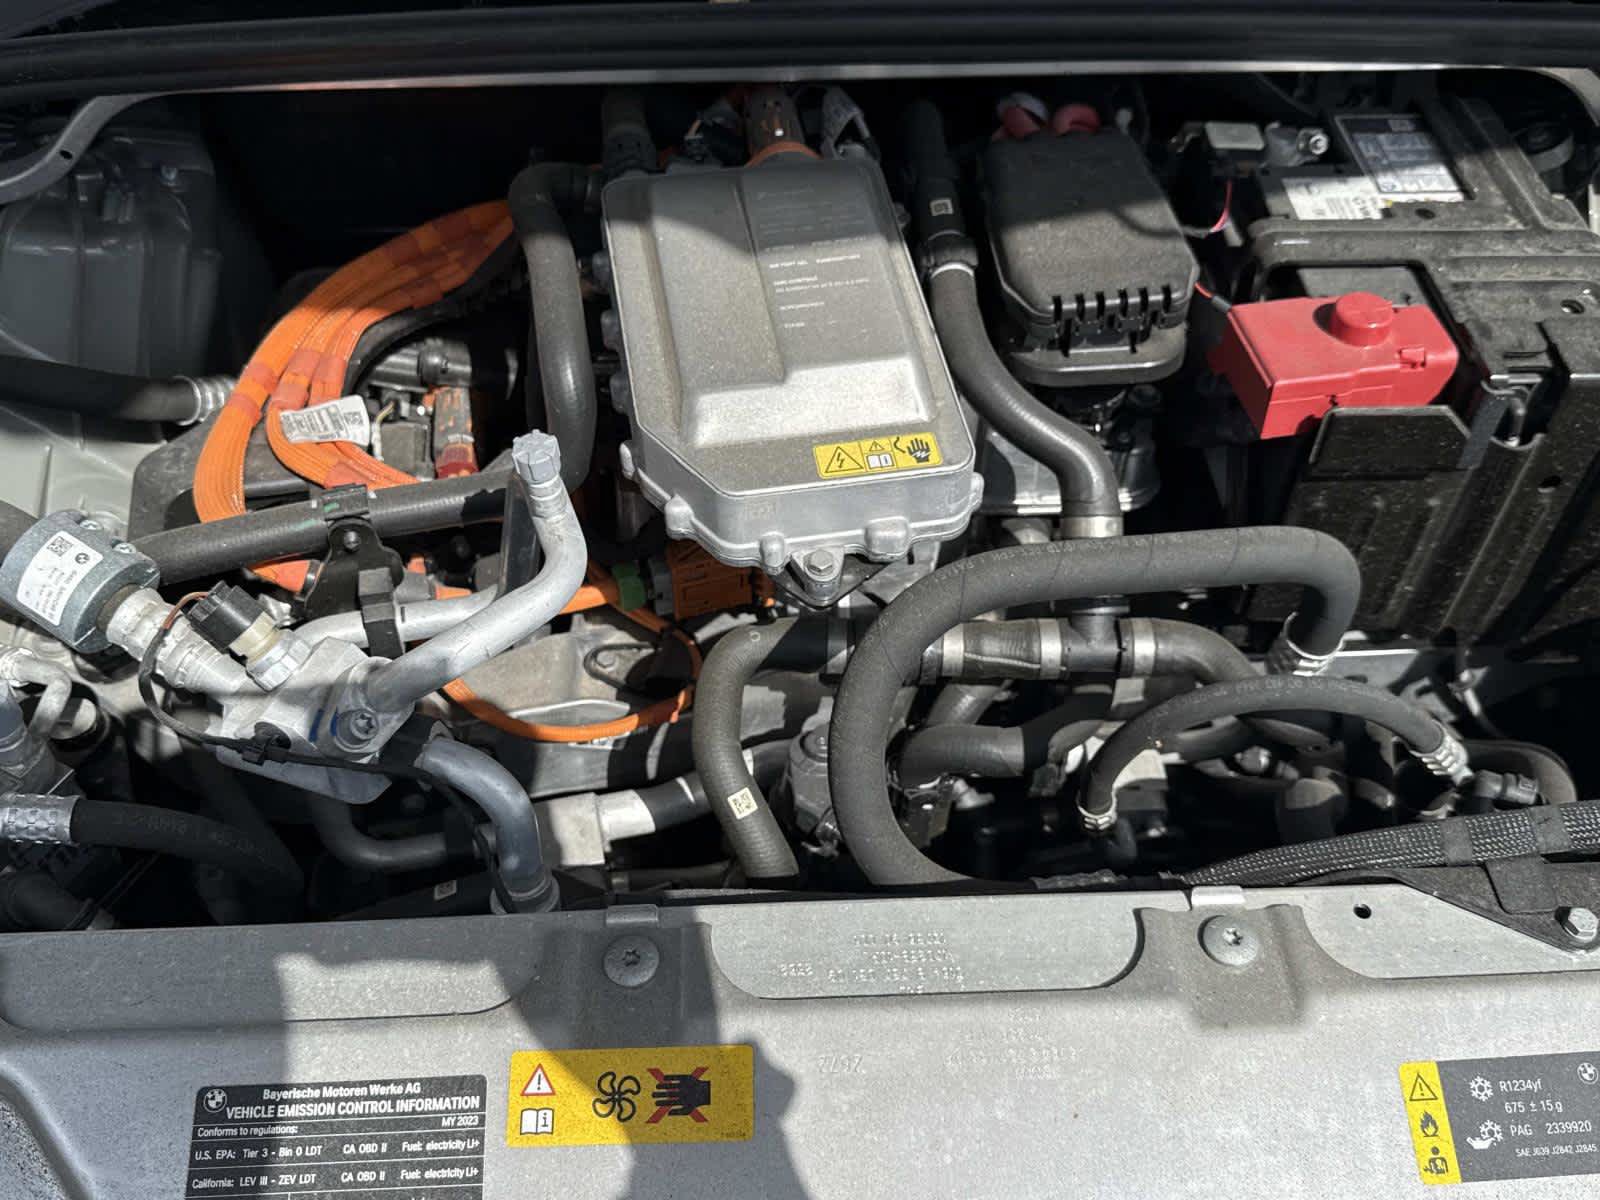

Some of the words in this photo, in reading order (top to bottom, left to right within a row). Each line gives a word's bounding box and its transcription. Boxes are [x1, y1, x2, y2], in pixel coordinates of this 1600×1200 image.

[263, 1088, 320, 1101] Bayerische
[322, 1086, 367, 1098] Motoren
[369, 1084, 403, 1095] Werke
[405, 1082, 421, 1094] AG
[1499, 1079, 1542, 1093] R1234yf
[226, 1105, 276, 1119] VEHICLE
[277, 1102, 335, 1117] EMISSION
[337, 1100, 394, 1115] CONTROL
[396, 1096, 480, 1112] INFORMATION
[1504, 1101, 1525, 1114] 675
[1529, 1101, 1538, 1112] ±
[1540, 1099, 1553, 1111] 15
[1555, 1101, 1563, 1113] g
[442, 1117, 455, 1127] MY
[457, 1115, 479, 1126] 2023
[1510, 1124, 1533, 1136] PAG
[1545, 1120, 1592, 1135] 2339920
[198, 1127, 238, 1137] Conforms
[240, 1127, 248, 1135] to
[250, 1125, 298, 1136] regulations:
[195, 1150, 212, 1160] U.S.
[216, 1149, 235, 1159] EPA:
[243, 1148, 258, 1158] Tier
[262, 1148, 268, 1158] 3
[279, 1147, 293, 1157] Bin
[305, 1145, 322, 1155] LDT
[343, 1144, 355, 1154] CA
[359, 1143, 378, 1154] OBD
[381, 1142, 387, 1153] II
[402, 1141, 422, 1152] Fuel:
[426, 1140, 466, 1151] electricity
[1516, 1147, 1531, 1157] SAE
[192, 1178, 234, 1189] California:
[240, 1176, 256, 1186] LEV
[259, 1176, 267, 1185] III
[278, 1175, 297, 1185] ZEV
[299, 1173, 316, 1184] LDT
[341, 1172, 353, 1182] CA
[357, 1171, 376, 1182] OBD
[400, 1169, 421, 1180] Fuel:
[424, 1168, 464, 1179] electricity
